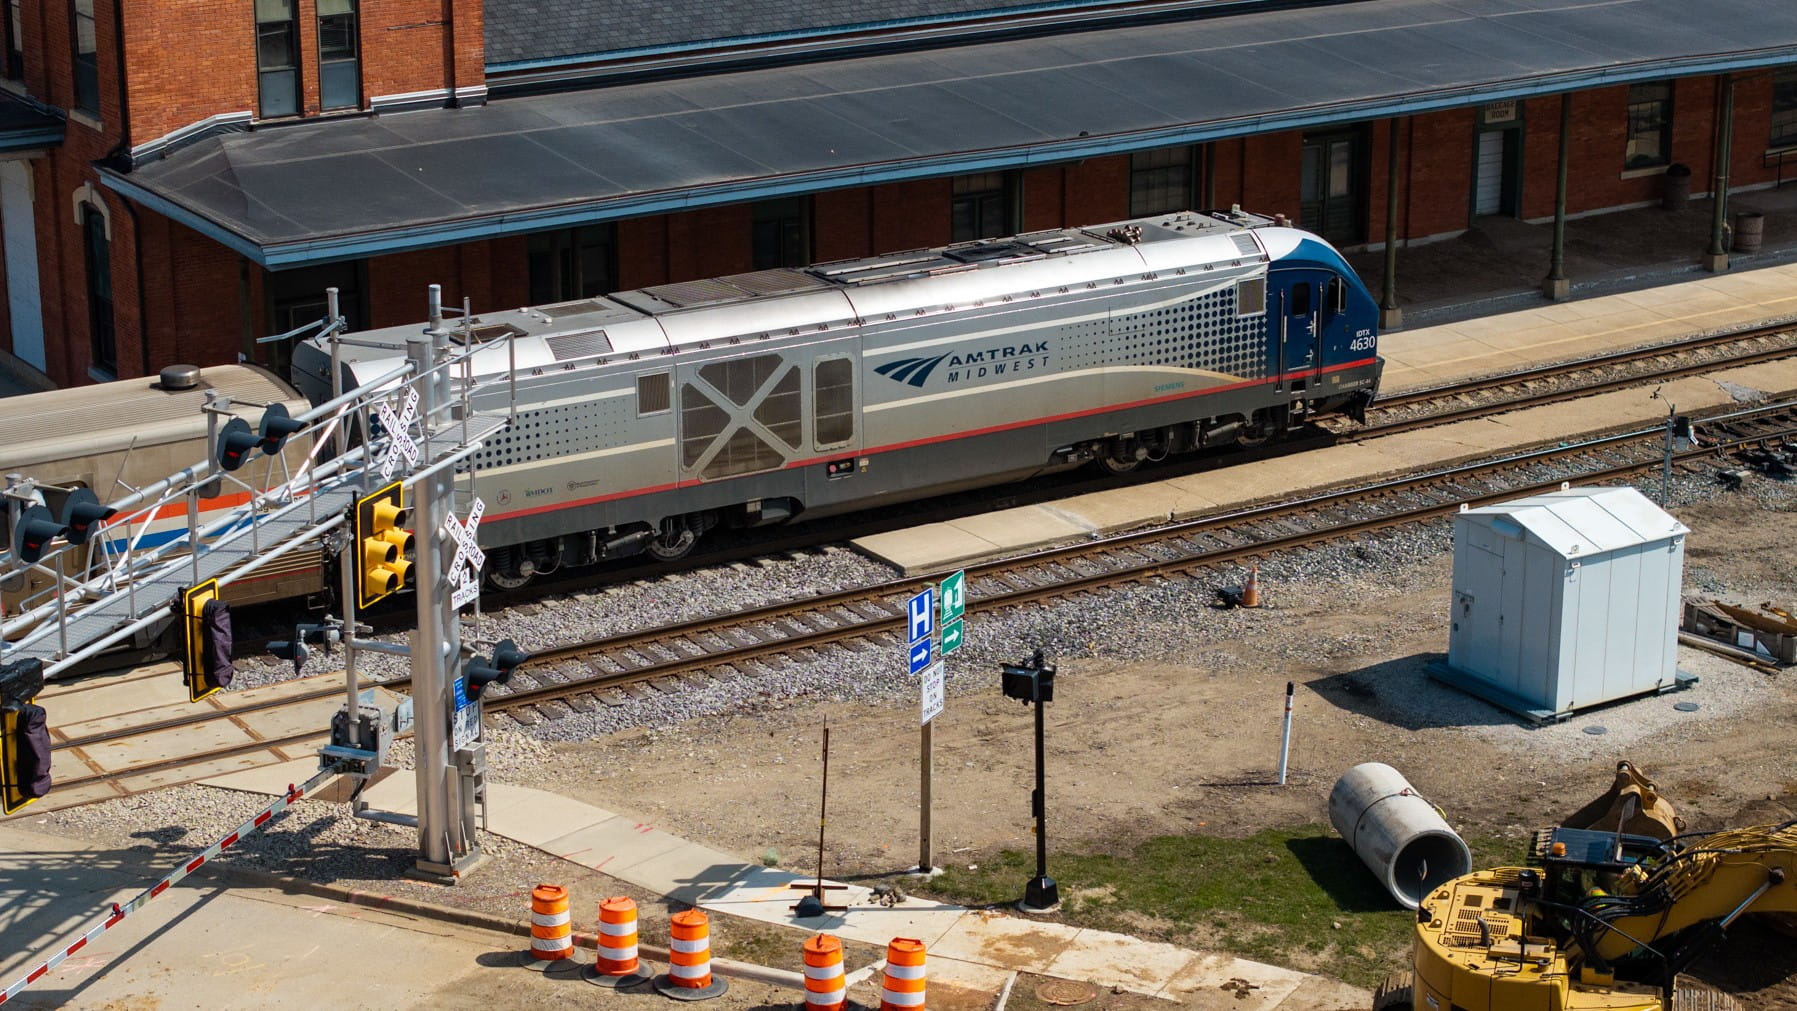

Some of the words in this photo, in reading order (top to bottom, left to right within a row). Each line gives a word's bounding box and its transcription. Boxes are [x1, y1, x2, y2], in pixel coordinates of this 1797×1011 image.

[1350, 336, 1376, 351] 4630
[948, 341, 1049, 367] AMTRAK
[948, 356, 1049, 383] MIDWEST
[384, 392, 417, 477] CROSSING
[450, 502, 483, 582] CROSSING
[462, 571, 468, 584] 2
[453, 584, 478, 604] TRACKS
[911, 593, 930, 640] H
[924, 674, 931, 684] DO
[926, 679, 940, 693] STOP
[929, 692, 937, 703] ON
[453, 703, 477, 725] STOP
[923, 698, 943, 718] TRACKS
[466, 715, 478, 730] RED
[455, 727, 478, 748] SIGNAL
